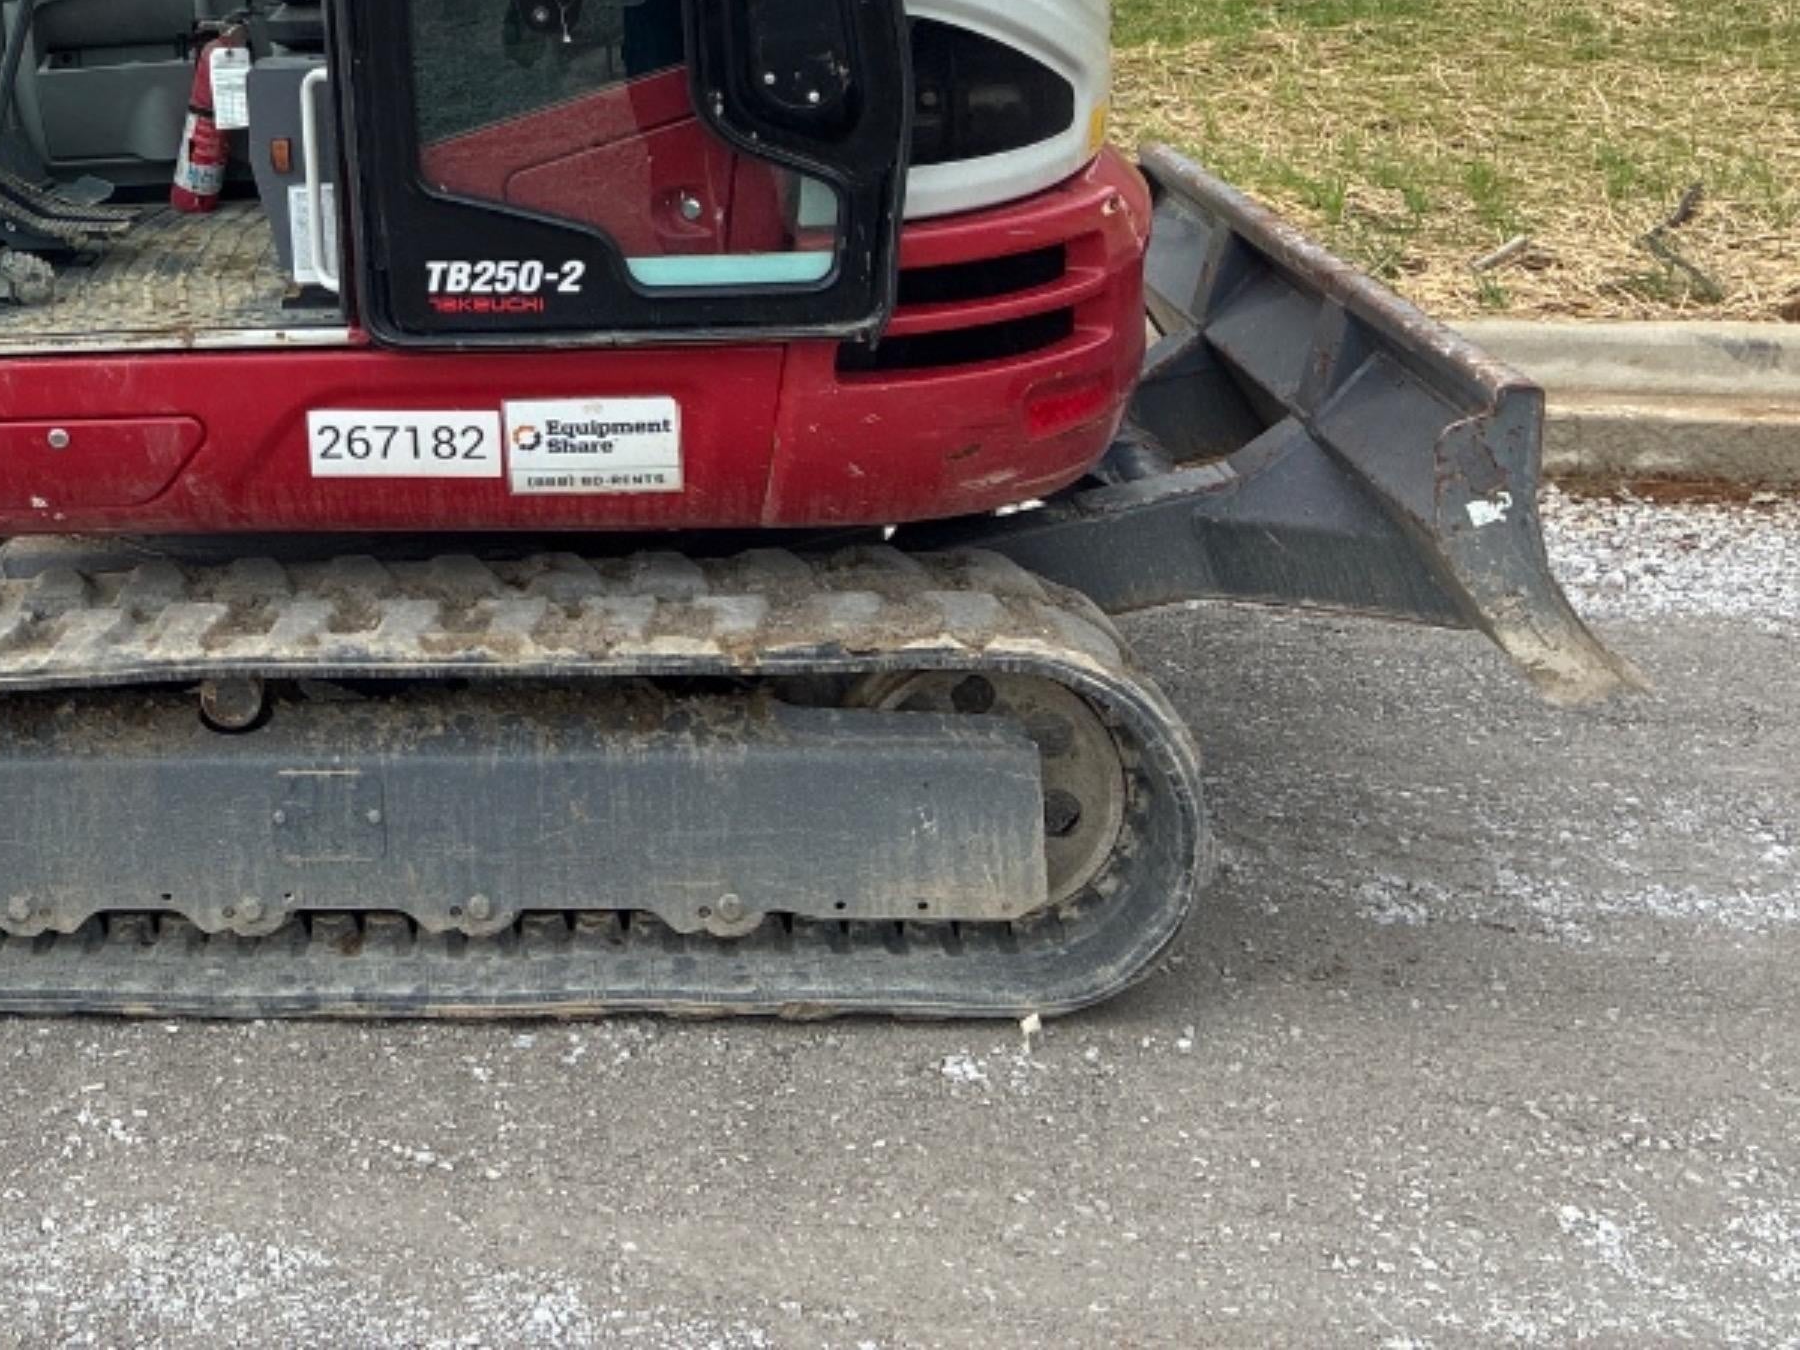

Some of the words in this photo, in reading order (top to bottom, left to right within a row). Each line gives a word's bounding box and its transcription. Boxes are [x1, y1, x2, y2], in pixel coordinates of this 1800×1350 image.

[425, 260, 586, 293] TB250-2
[545, 419, 672, 438] Equipment
[316, 425, 487, 460] 267182
[546, 438, 614, 454] Share
